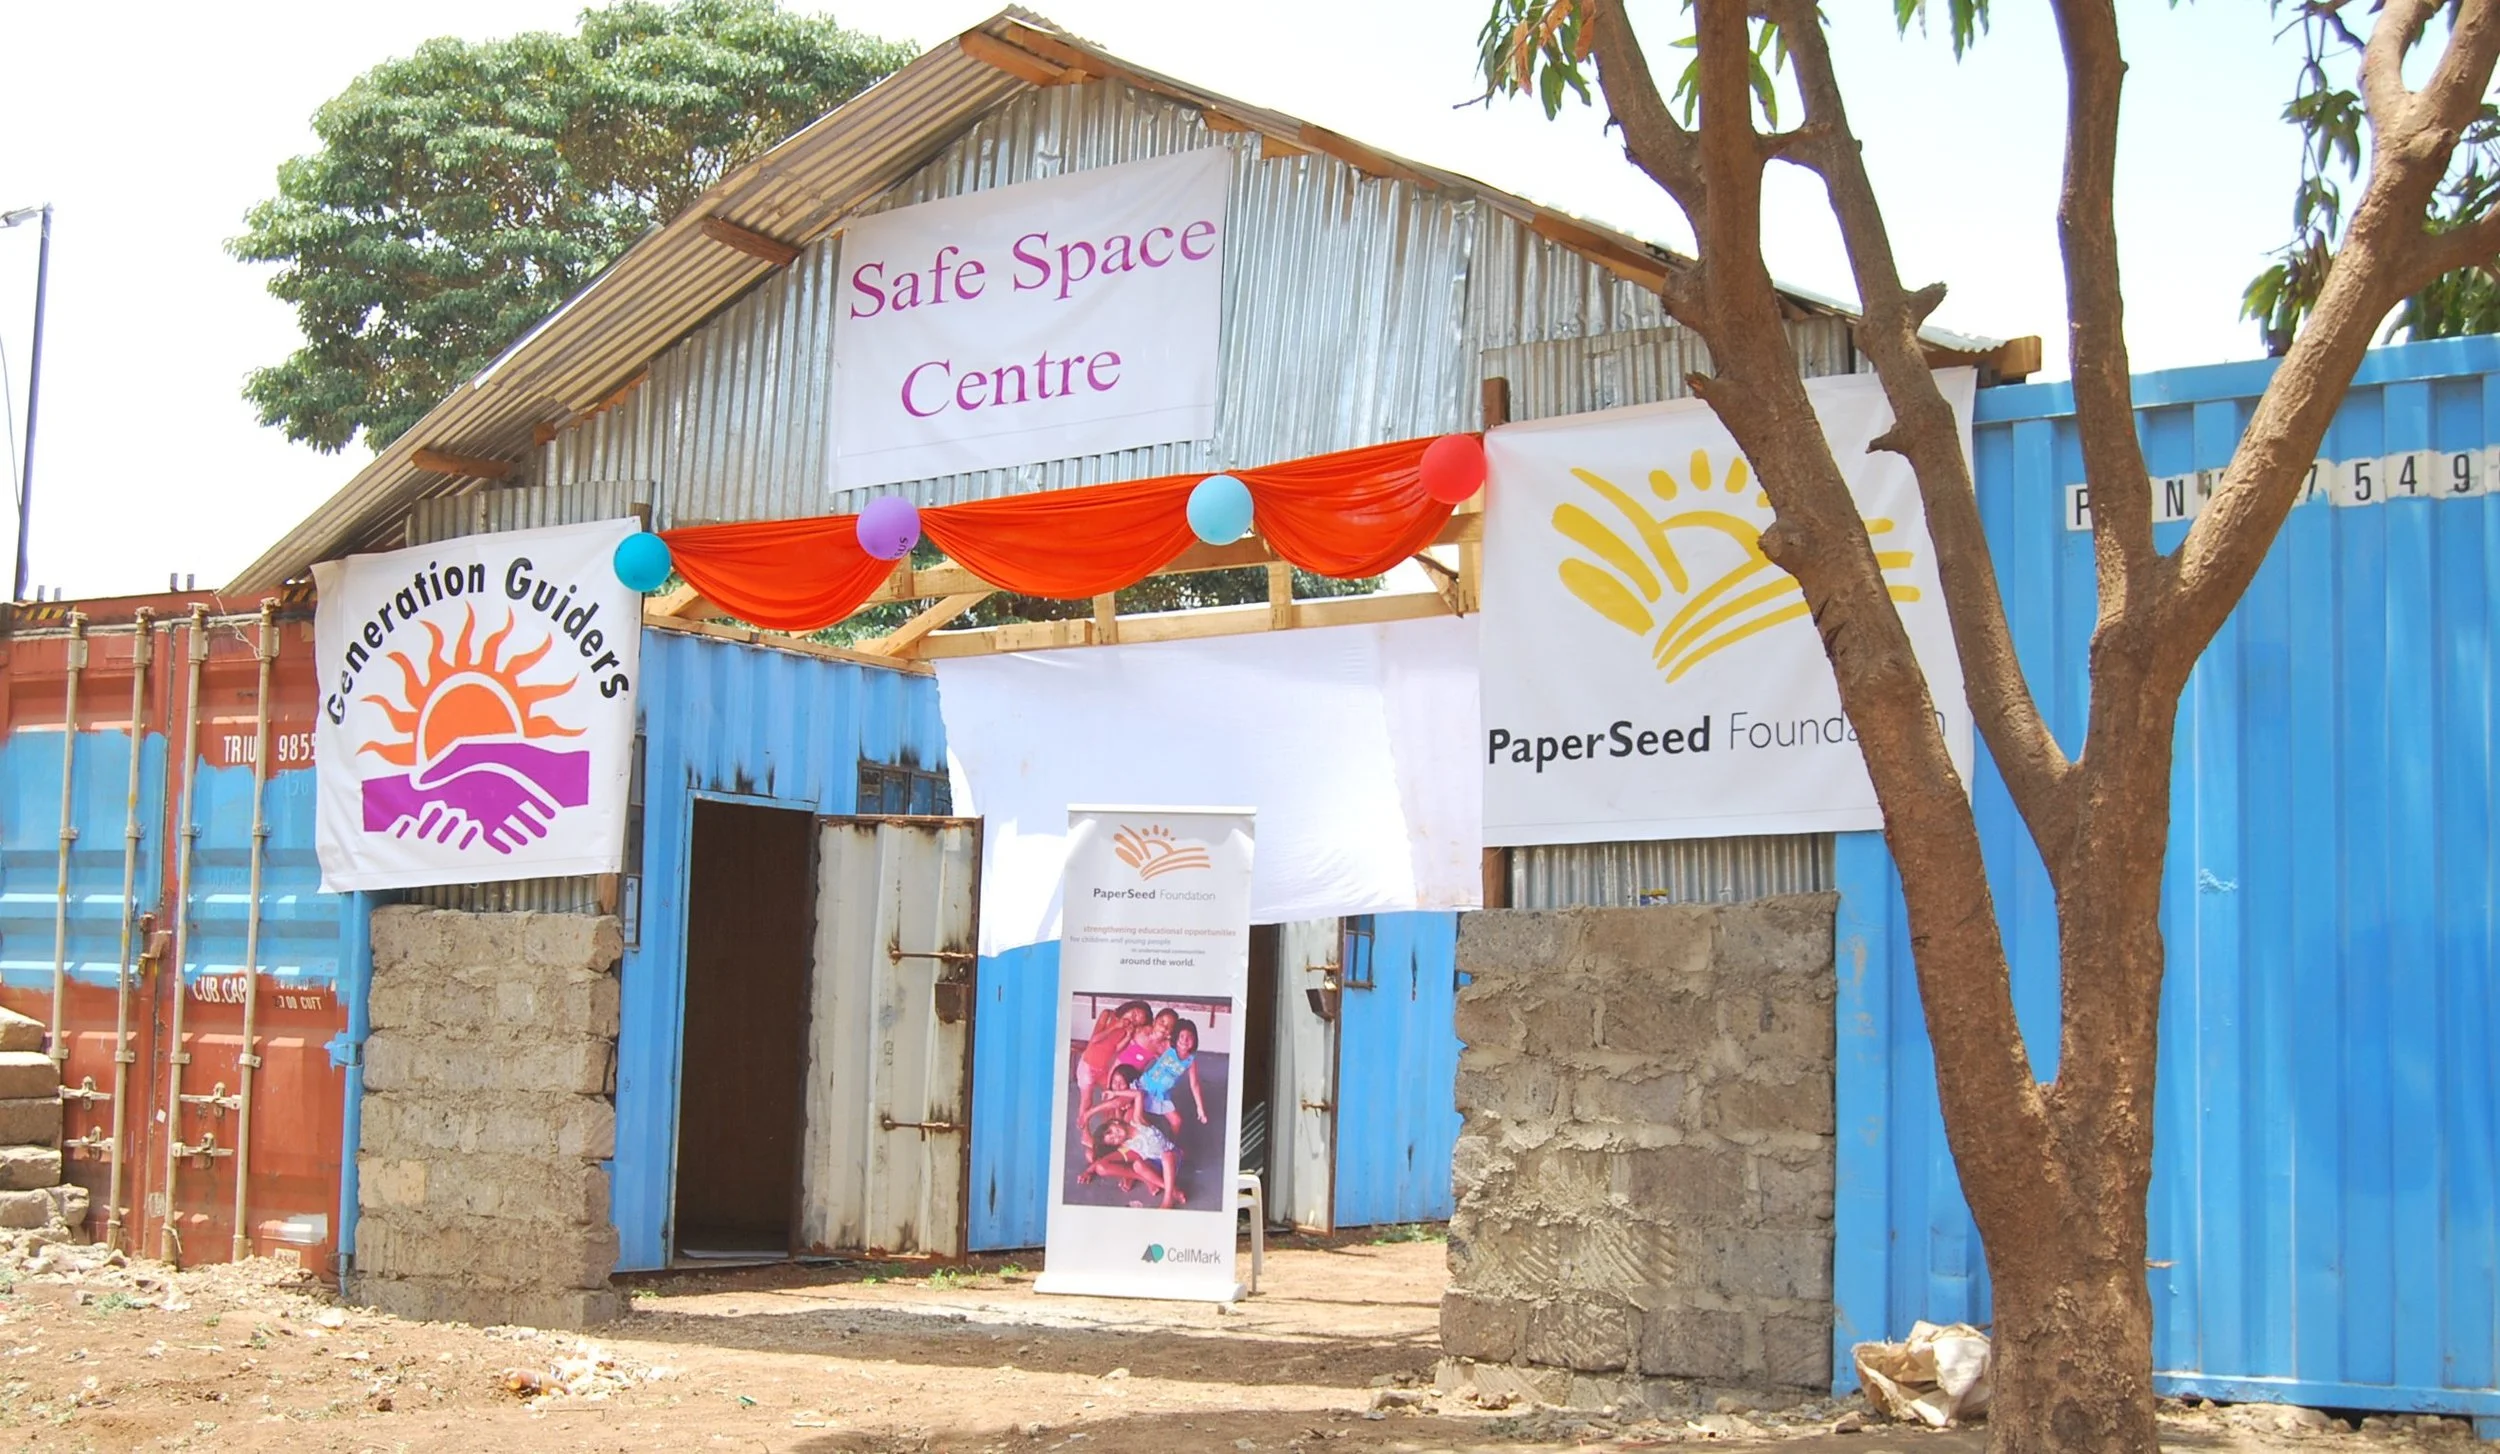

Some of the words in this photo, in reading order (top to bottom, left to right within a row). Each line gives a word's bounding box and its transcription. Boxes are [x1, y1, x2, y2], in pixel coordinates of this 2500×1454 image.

[850, 246, 986, 320] Safe
[1012, 220, 1217, 301] Space
[901, 350, 1121, 418] Centre
[327, 561, 485, 725] Generation
[505, 557, 629, 698] Guiders
[223, 735, 257, 763] TRIU
[1489, 716, 1711, 773] PaperSeed
[1730, 705, 1946, 750] Foundn
[1093, 888, 1156, 901] PaperSeed
[1160, 889, 1216, 901] Foundation
[1083, 925, 1136, 935] strengthening
[1138, 926, 1182, 935] educational
[1184, 927, 1236, 937] opportunities
[1125, 938, 1146, 946] young
[1147, 938, 1171, 946] people
[1120, 957, 1150, 965] around
[1169, 958, 1195, 966] world.
[1167, 1247, 1221, 1264] CellMark
